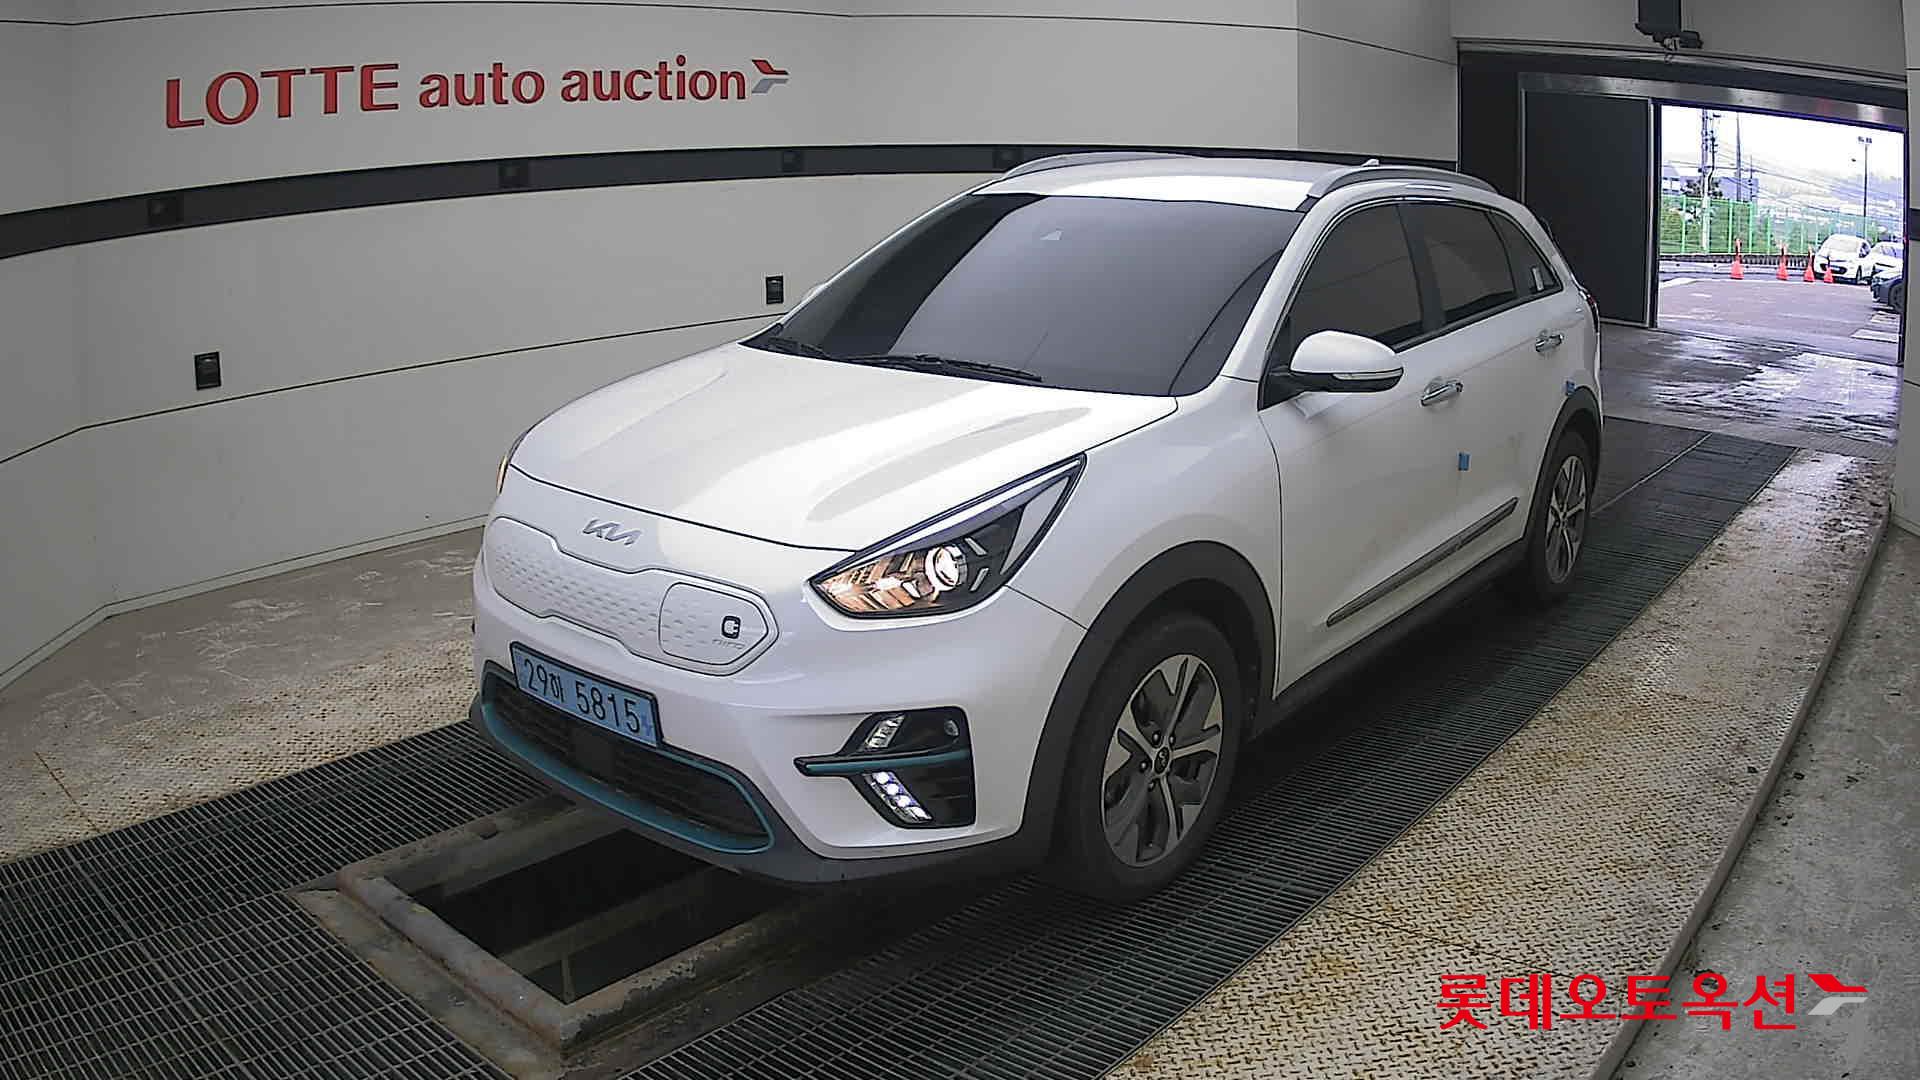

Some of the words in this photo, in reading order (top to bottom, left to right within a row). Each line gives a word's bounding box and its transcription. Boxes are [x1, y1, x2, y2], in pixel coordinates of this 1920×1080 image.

[166, 63, 400, 129] LOTTE
[419, 62, 546, 108] auto
[560, 54, 747, 104] auction
[575, 680, 641, 734] 5815
